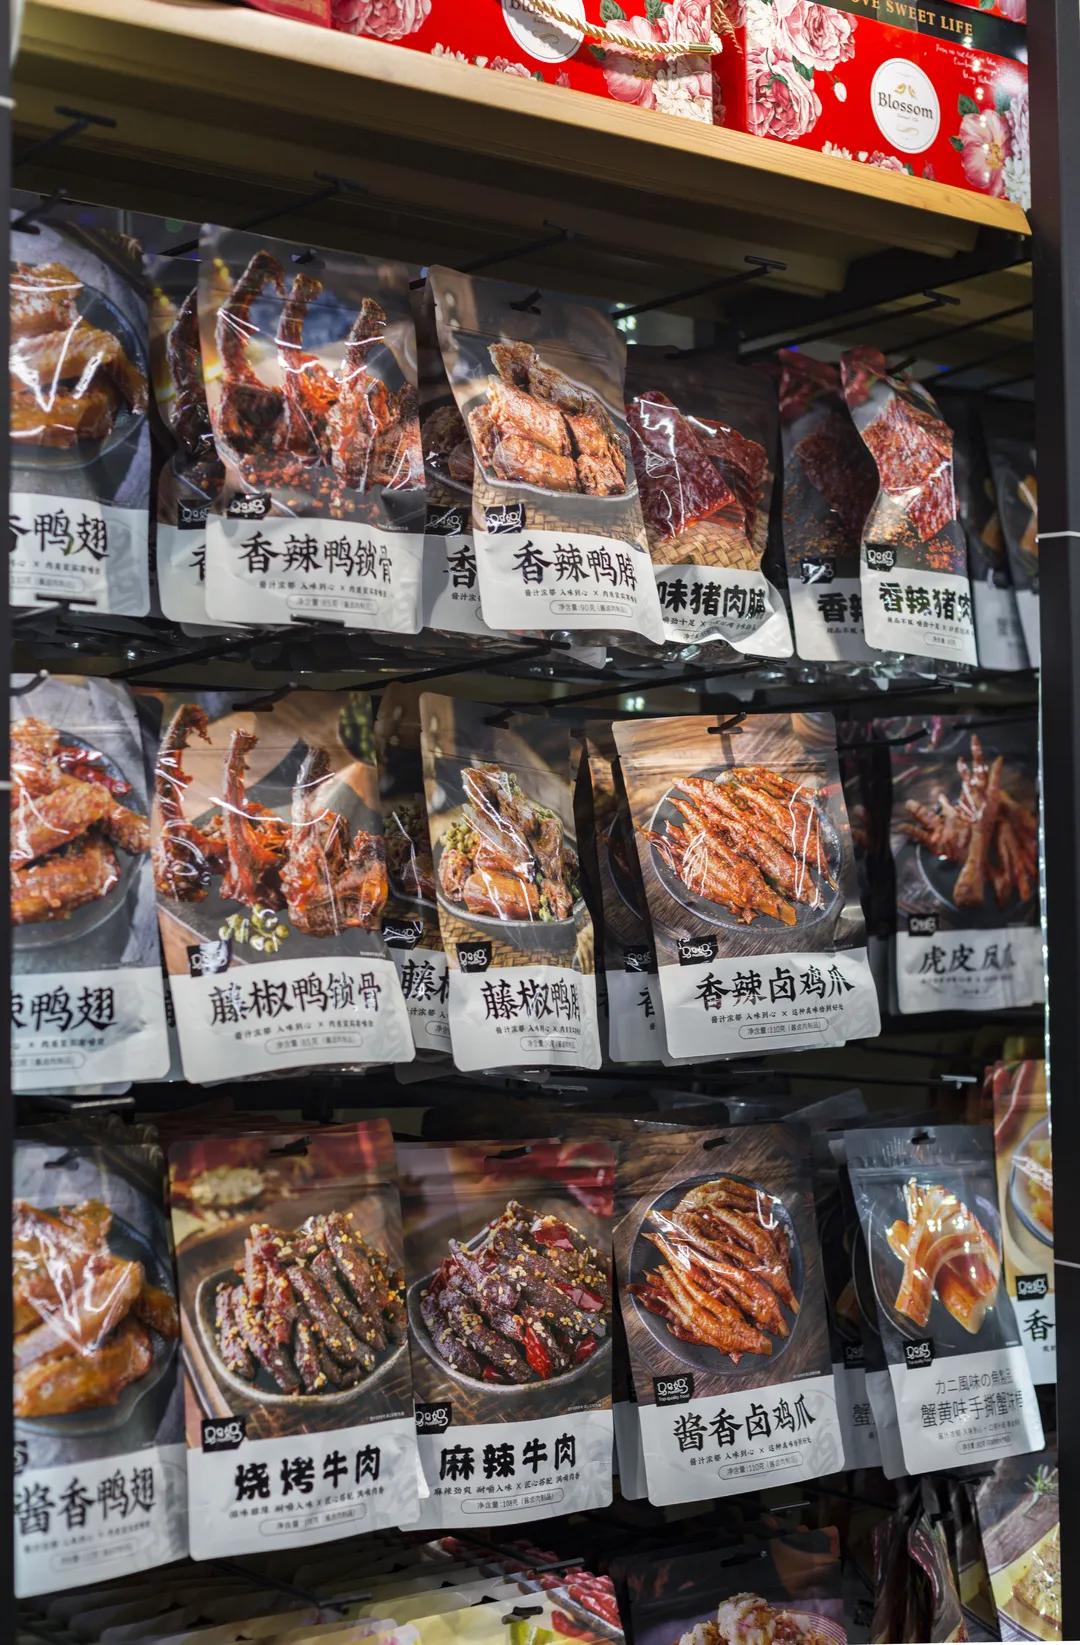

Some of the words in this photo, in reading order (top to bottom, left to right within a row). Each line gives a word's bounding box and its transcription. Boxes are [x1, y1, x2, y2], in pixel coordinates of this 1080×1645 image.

[886, 0, 936, 27] SWEET
[940, 15, 973, 36] LIFE
[877, 91, 933, 119] Blossom
[238, 530, 393, 585] 香辣鸭锁骨
[208, 971, 382, 1027] 藤椒鸭锁骨
[694, 964, 856, 1012] 香辣卤鸡爪
[1024, 1308, 1056, 1342] 香
[672, 1393, 816, 1453] 酱香卤鸡爪
[234, 1443, 382, 1502] 烧烤牛肉
[439, 1433, 576, 1481] 麻辣牛肉
[13, 1466, 156, 1536] 酱香鸭翅
